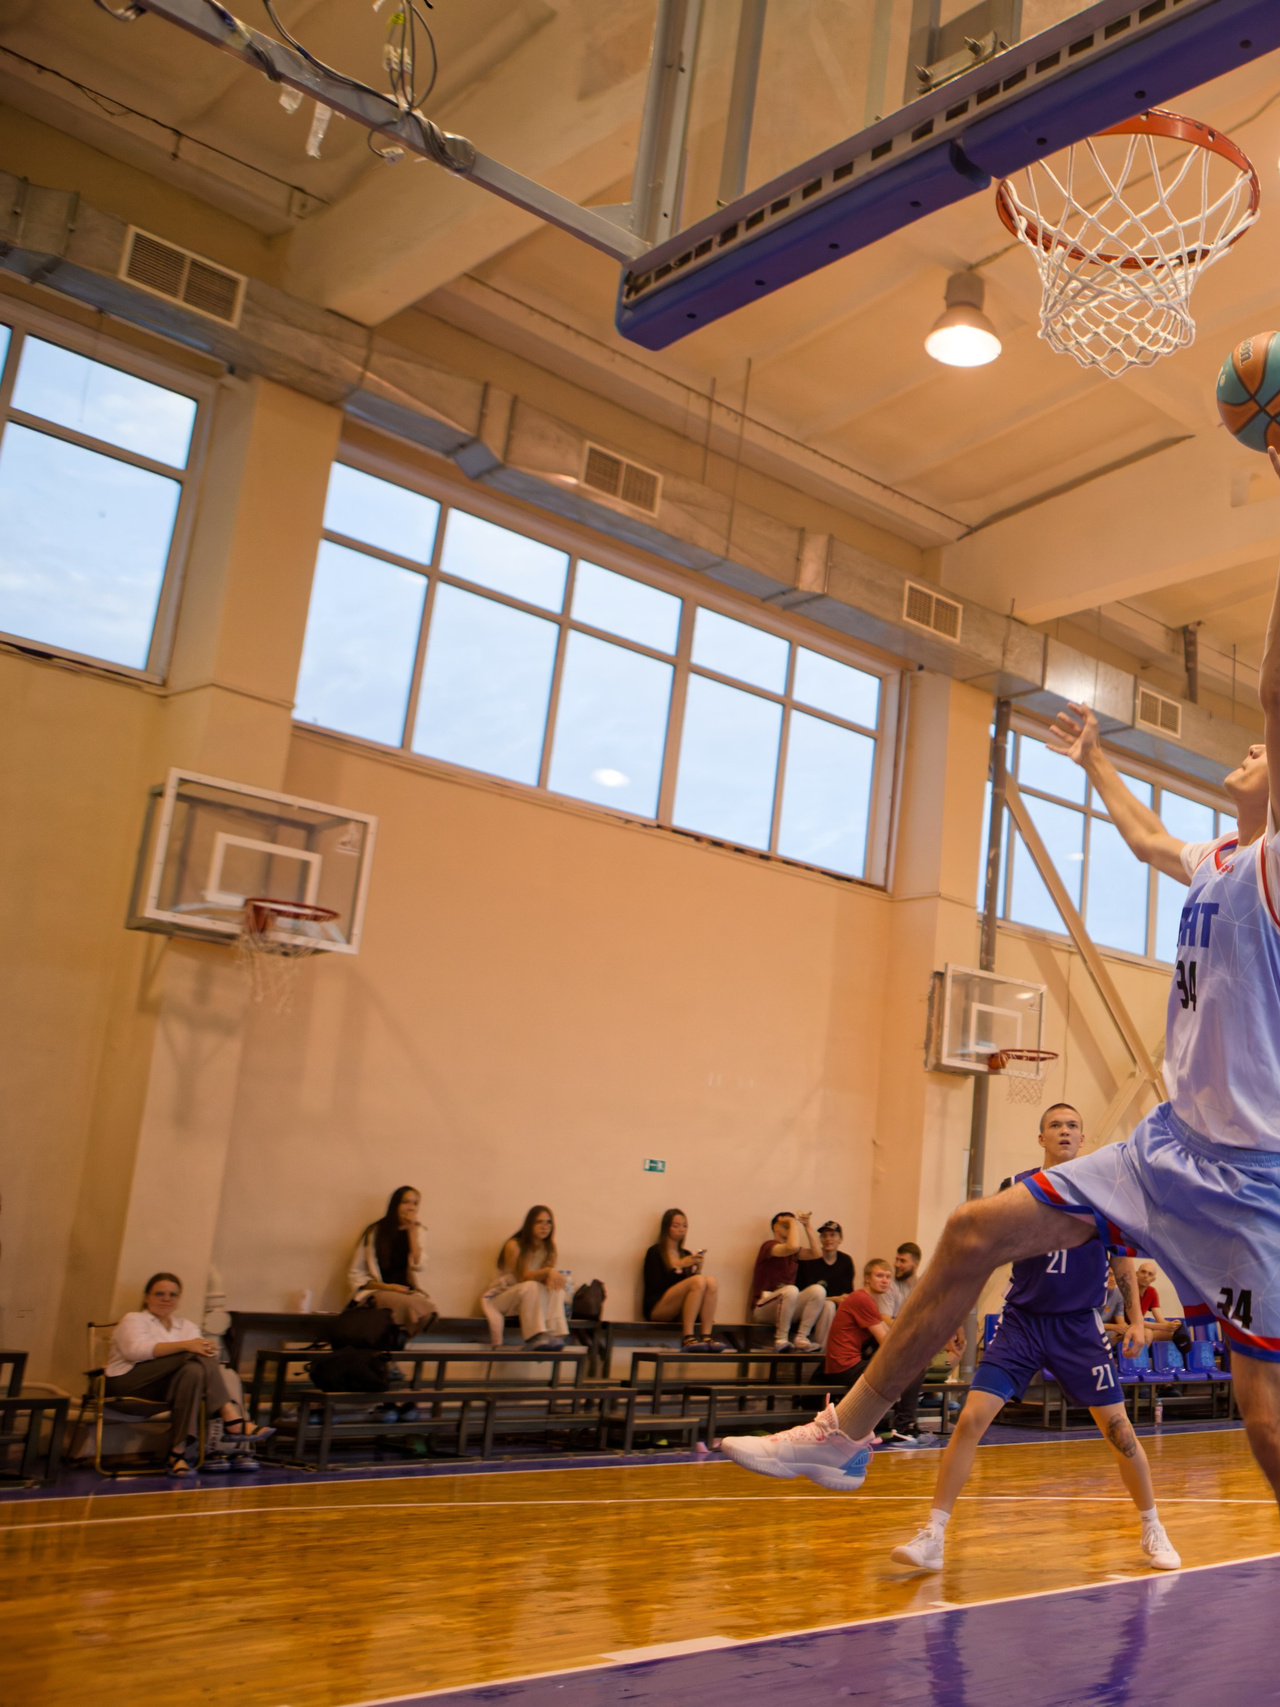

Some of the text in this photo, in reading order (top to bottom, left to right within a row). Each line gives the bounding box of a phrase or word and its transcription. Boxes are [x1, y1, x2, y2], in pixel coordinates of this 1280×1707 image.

[1176, 960, 1197, 1012] 34
[1046, 1249, 1068, 1274] 21
[1092, 1363, 1115, 1391] 21
